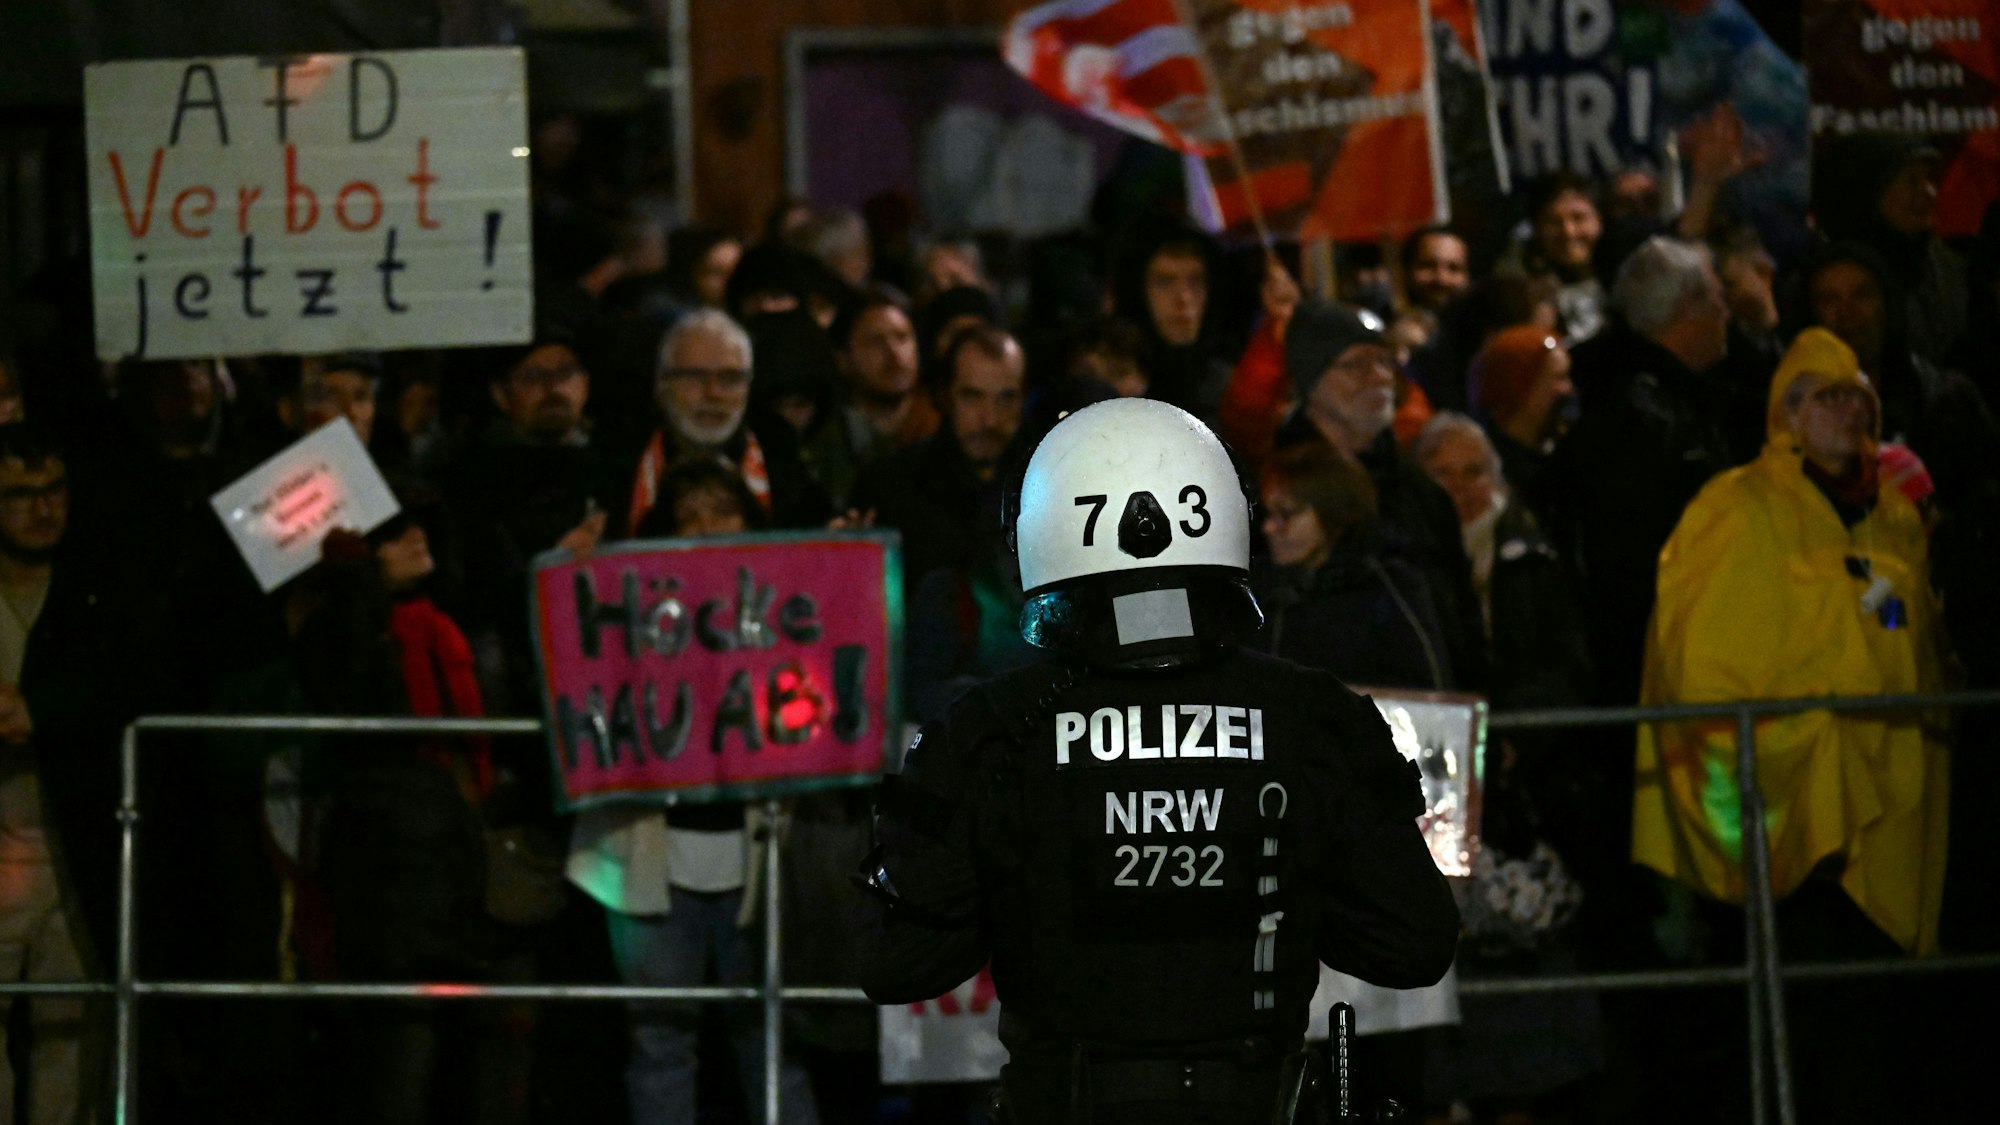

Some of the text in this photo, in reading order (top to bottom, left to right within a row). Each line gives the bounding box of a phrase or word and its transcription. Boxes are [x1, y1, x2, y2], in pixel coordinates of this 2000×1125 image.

[1862, 15, 1982, 53] gegen
[1264, 49, 1342, 84] den
[1890, 53, 1965, 89] den
[108, 136, 441, 239] Verbot
[1074, 484, 1212, 547] 7 3
[573, 564, 823, 661] Höcke
[556, 679, 693, 771] HAU
[1055, 704, 1265, 764] POLIZEI
[1105, 788, 1225, 834] NRW
[1114, 844, 1225, 887] 2732
